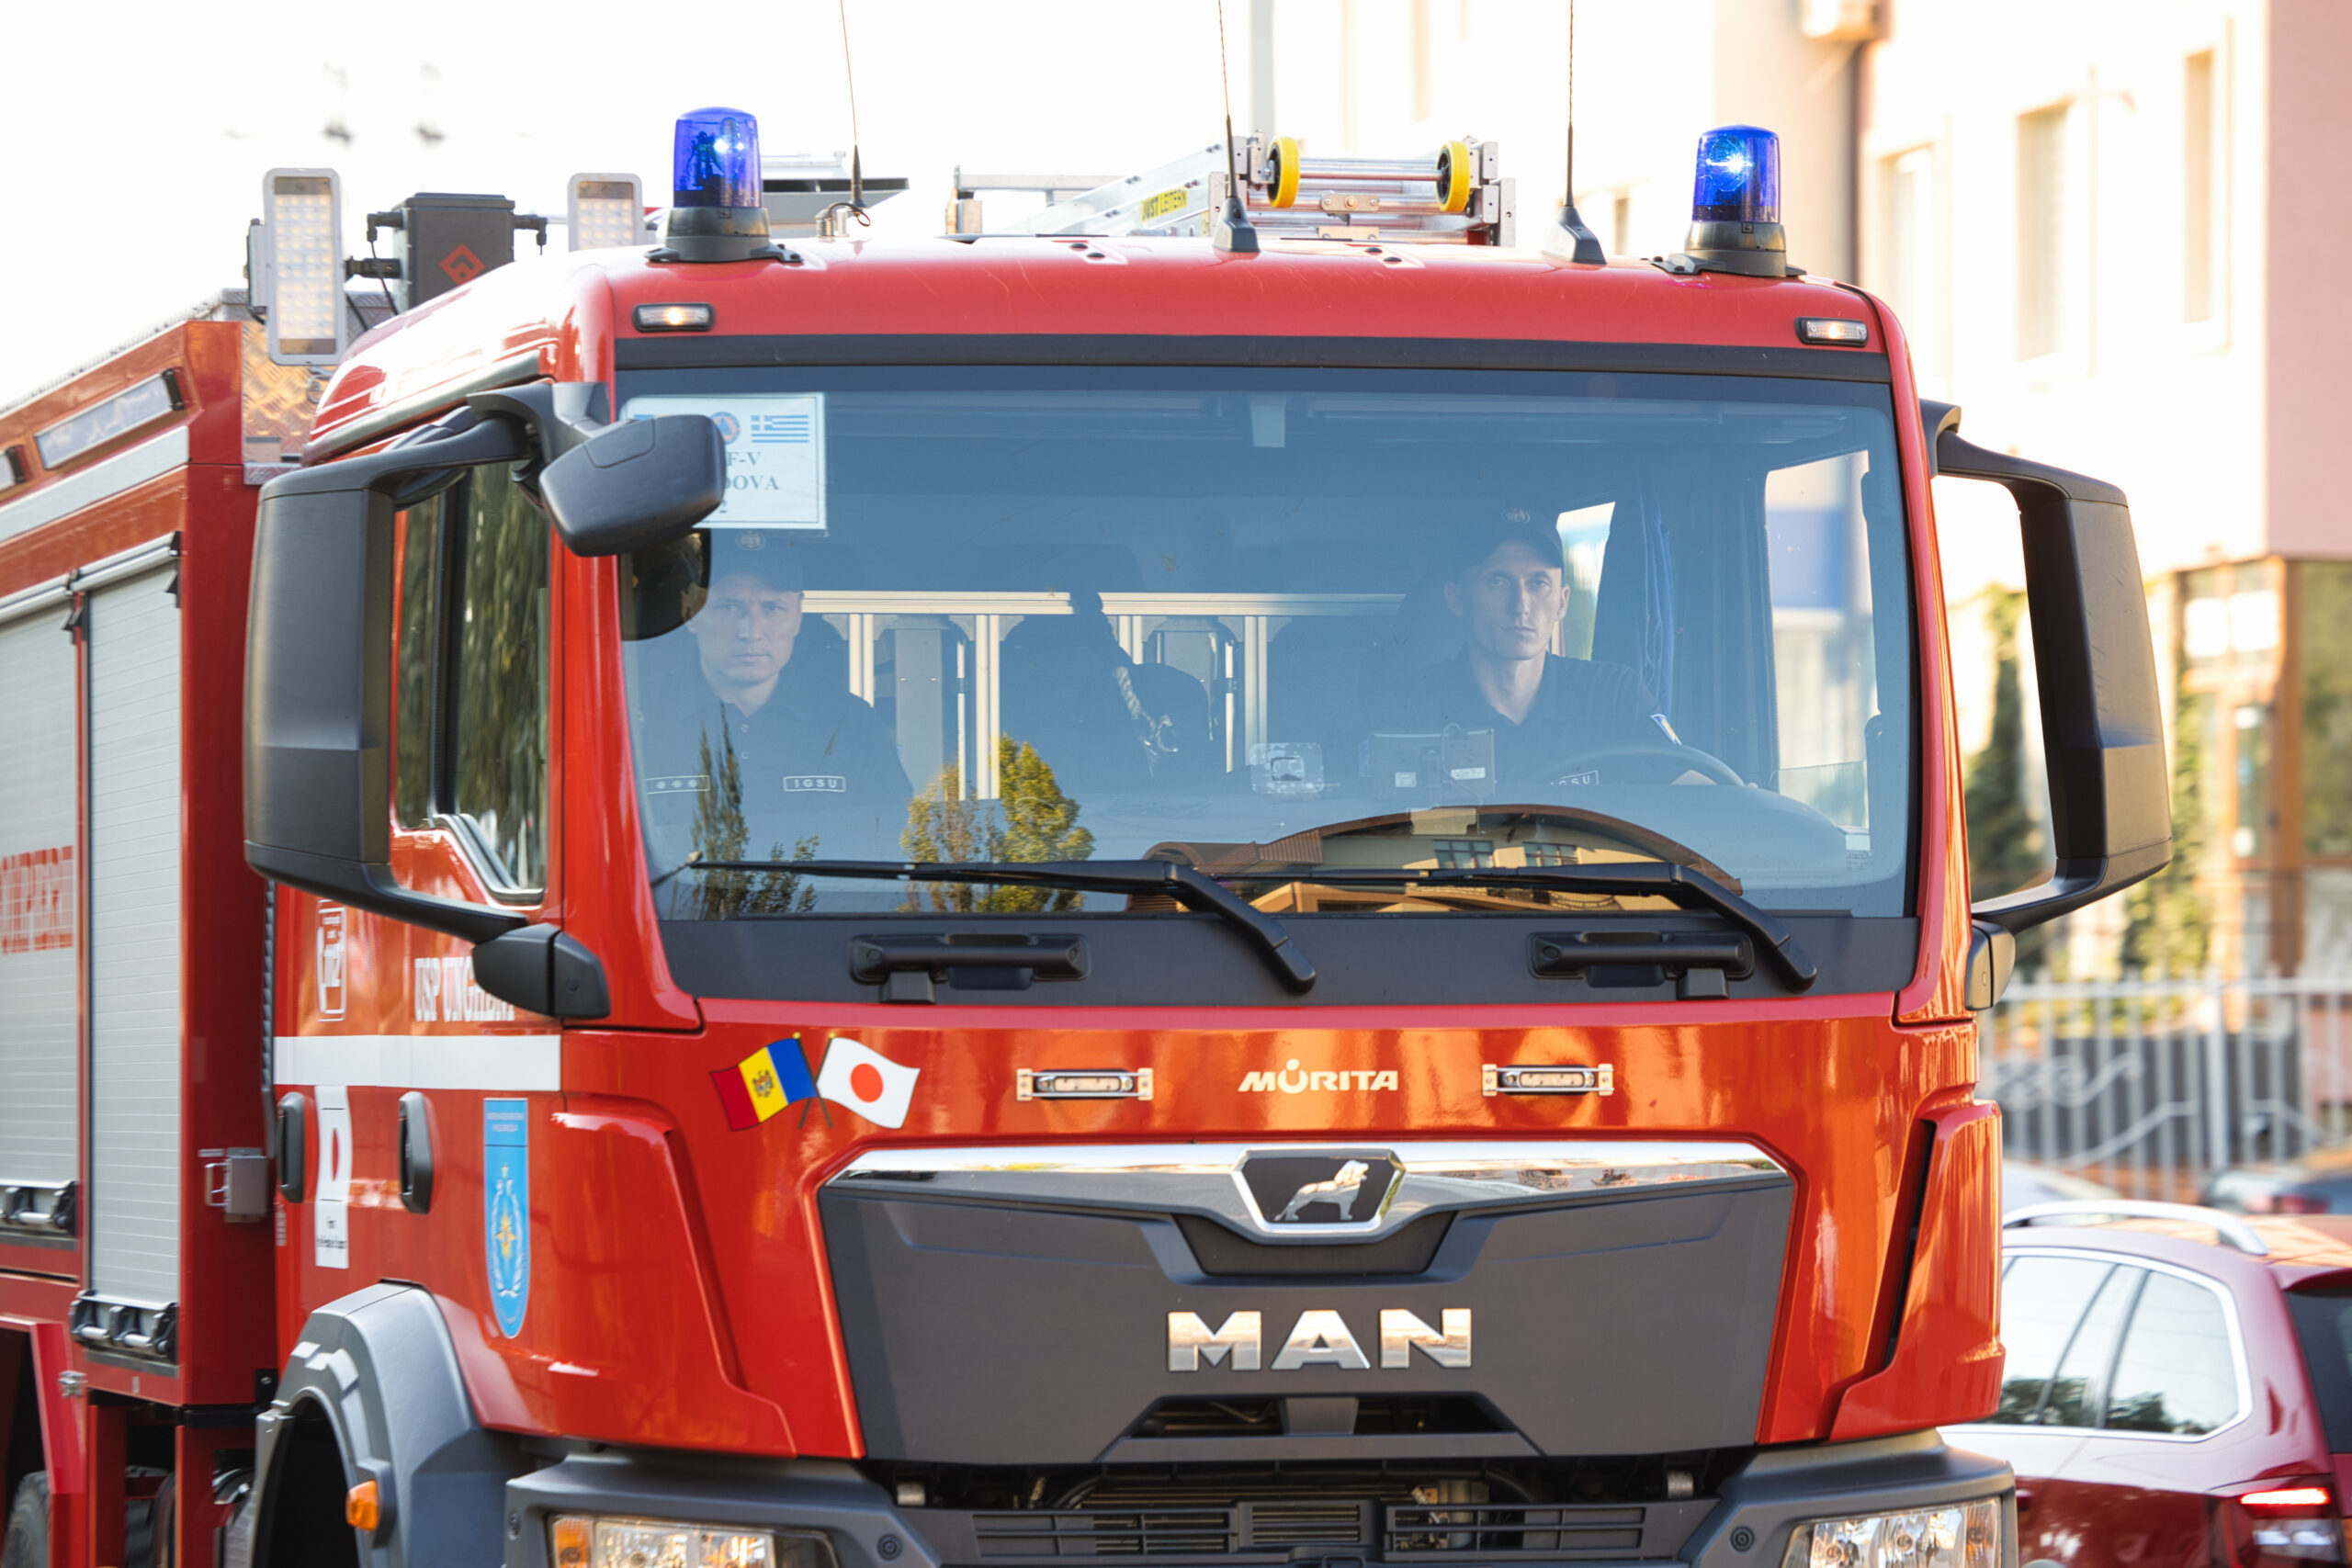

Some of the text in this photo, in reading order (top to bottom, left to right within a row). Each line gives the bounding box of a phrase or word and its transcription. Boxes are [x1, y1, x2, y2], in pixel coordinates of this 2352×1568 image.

[794, 779, 838, 788] IGSU
[1238, 1058, 1398, 1094] MORITA
[1168, 1308, 1471, 1371] MAN
